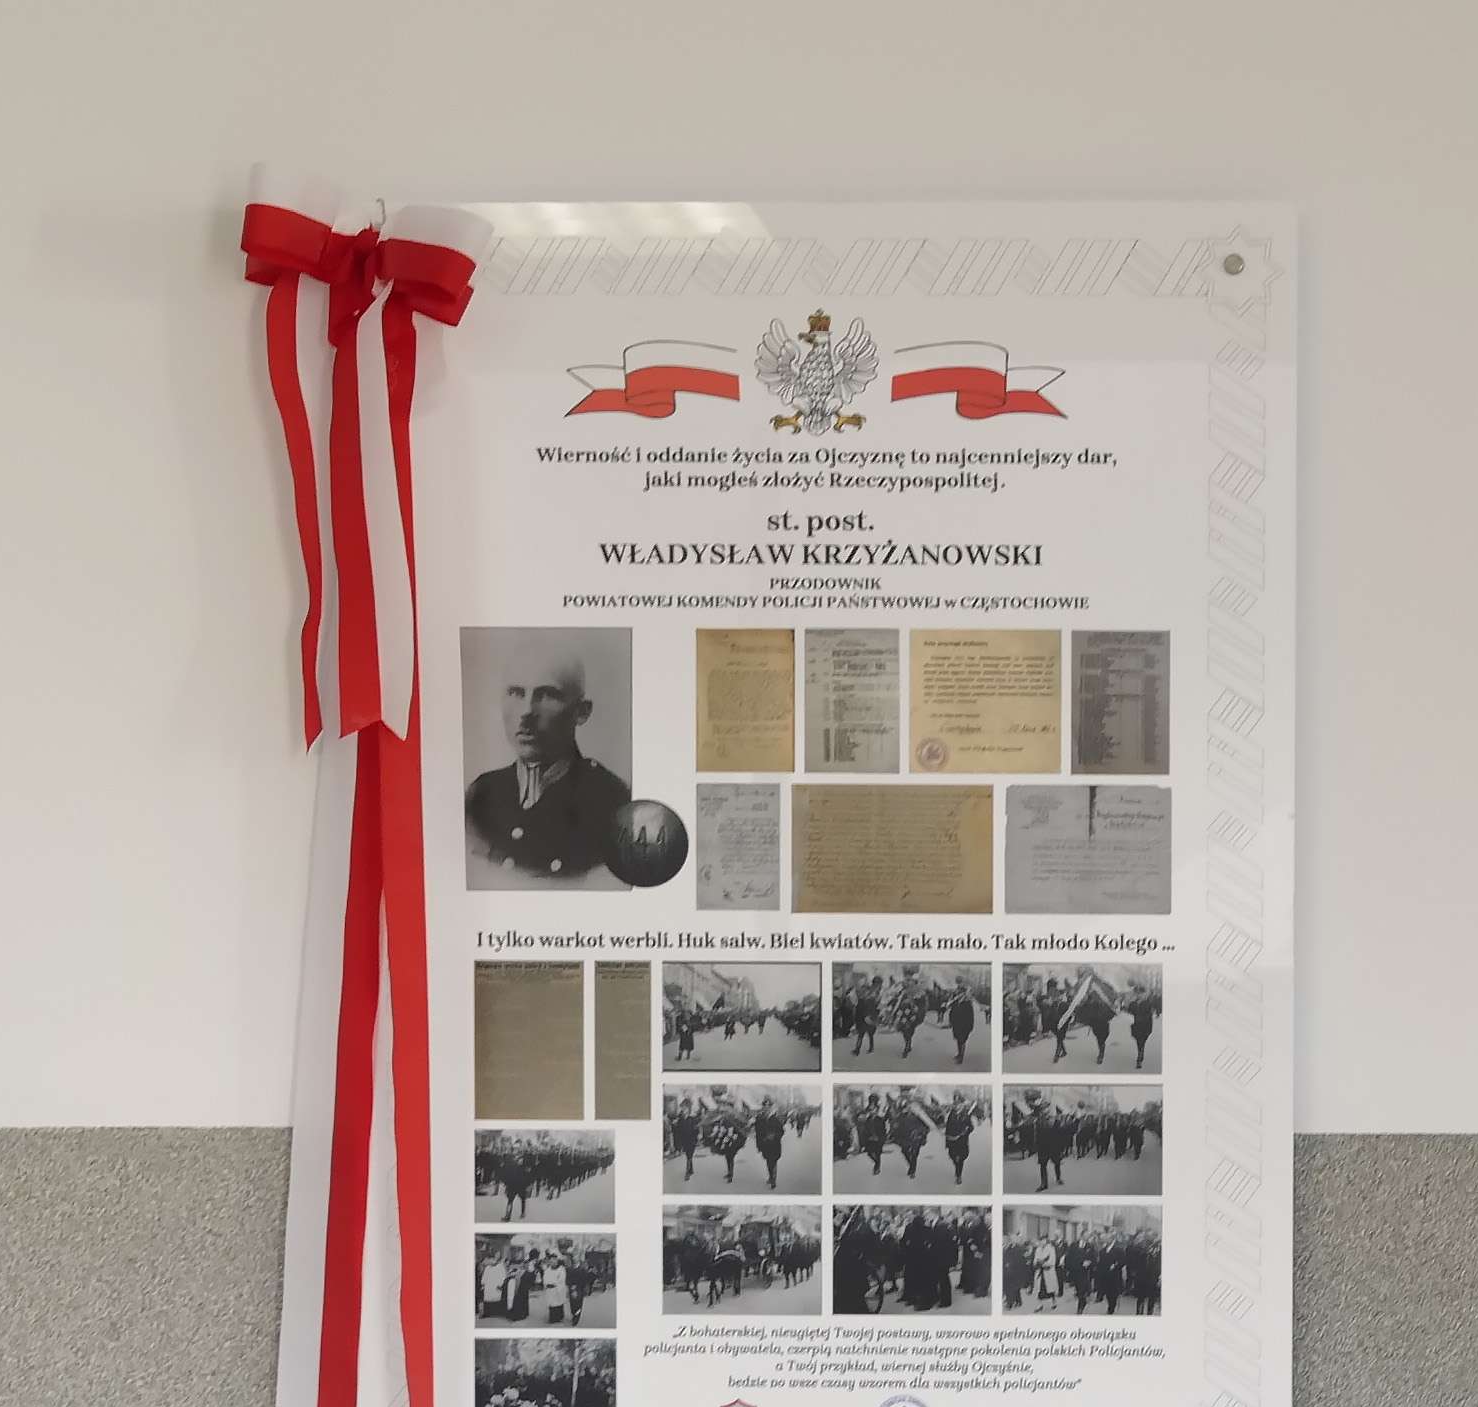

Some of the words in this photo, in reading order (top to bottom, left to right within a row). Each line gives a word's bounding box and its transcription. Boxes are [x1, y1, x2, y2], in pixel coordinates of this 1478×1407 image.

[537, 447, 630, 463] Wierność
[647, 447, 727, 463] oddanie
[732, 447, 783, 467] życia
[788, 451, 810, 463] za
[815, 447, 905, 470] Ojczyznę
[911, 449, 930, 464] to
[936, 447, 1072, 469] najcenniejszy
[1077, 447, 1116, 466] dar,
[644, 471, 681, 491] jaki
[688, 471, 757, 491] mogłeś
[762, 471, 824, 492] złożyć
[830, 470, 1005, 491] Rzeczypospolitej.
[768, 511, 799, 531] st.
[807, 511, 873, 537] post.
[600, 543, 794, 565] WŁADYSŁAW
[803, 539, 1041, 566] KRZYŻANOWSKI
[770, 577, 880, 590] PRZODOWNIK
[564, 595, 672, 609] POWIATOWEJ
[677, 596, 758, 609] KOMENDY
[763, 596, 822, 609] POLICJI
[827, 593, 940, 608] PAŃSTWOWEJ
[961, 596, 1088, 612] CZĘSTOCHOWIE
[489, 931, 534, 953] tylko
[540, 931, 604, 948] warkot
[610, 931, 673, 949] werbli.
[679, 931, 714, 948] Huk
[721, 931, 765, 948] salw.
[771, 931, 804, 949] Biel
[810, 931, 893, 950] kwiatów.
[897, 933, 931, 950] Tak
[937, 933, 987, 950] mało.
[991, 933, 1025, 950] Tak
[1032, 933, 1089, 950] młodo
[1095, 933, 1157, 955] Kolego
